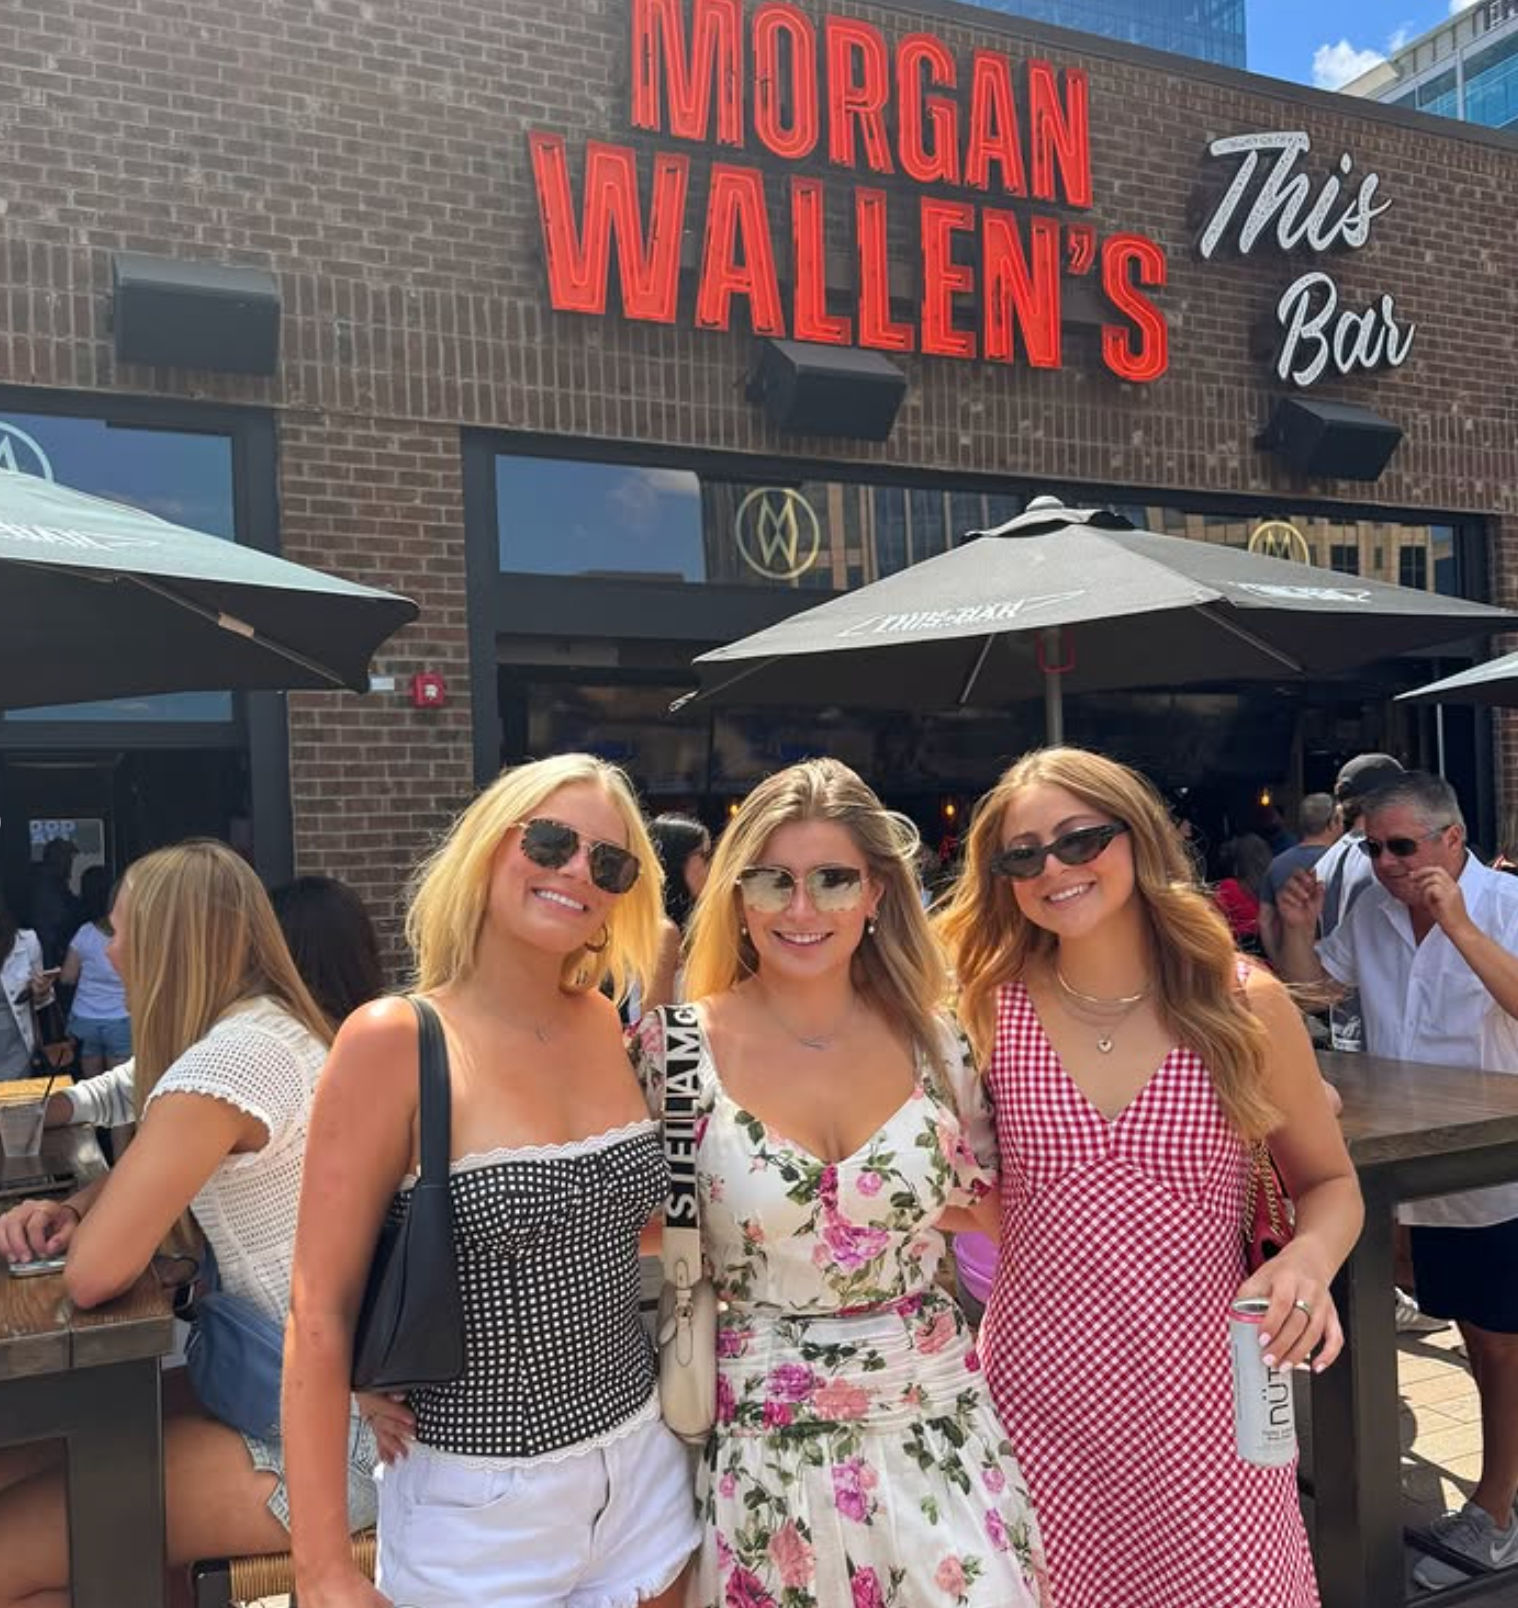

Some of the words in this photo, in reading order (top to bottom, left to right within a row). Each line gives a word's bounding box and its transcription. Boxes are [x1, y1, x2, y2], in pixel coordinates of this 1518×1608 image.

[630, 0, 1093, 209] MORGAN
[527, 130, 1168, 383] WALLEN'S
[1201, 131, 1392, 259] This
[1277, 272, 1415, 387] Bar
